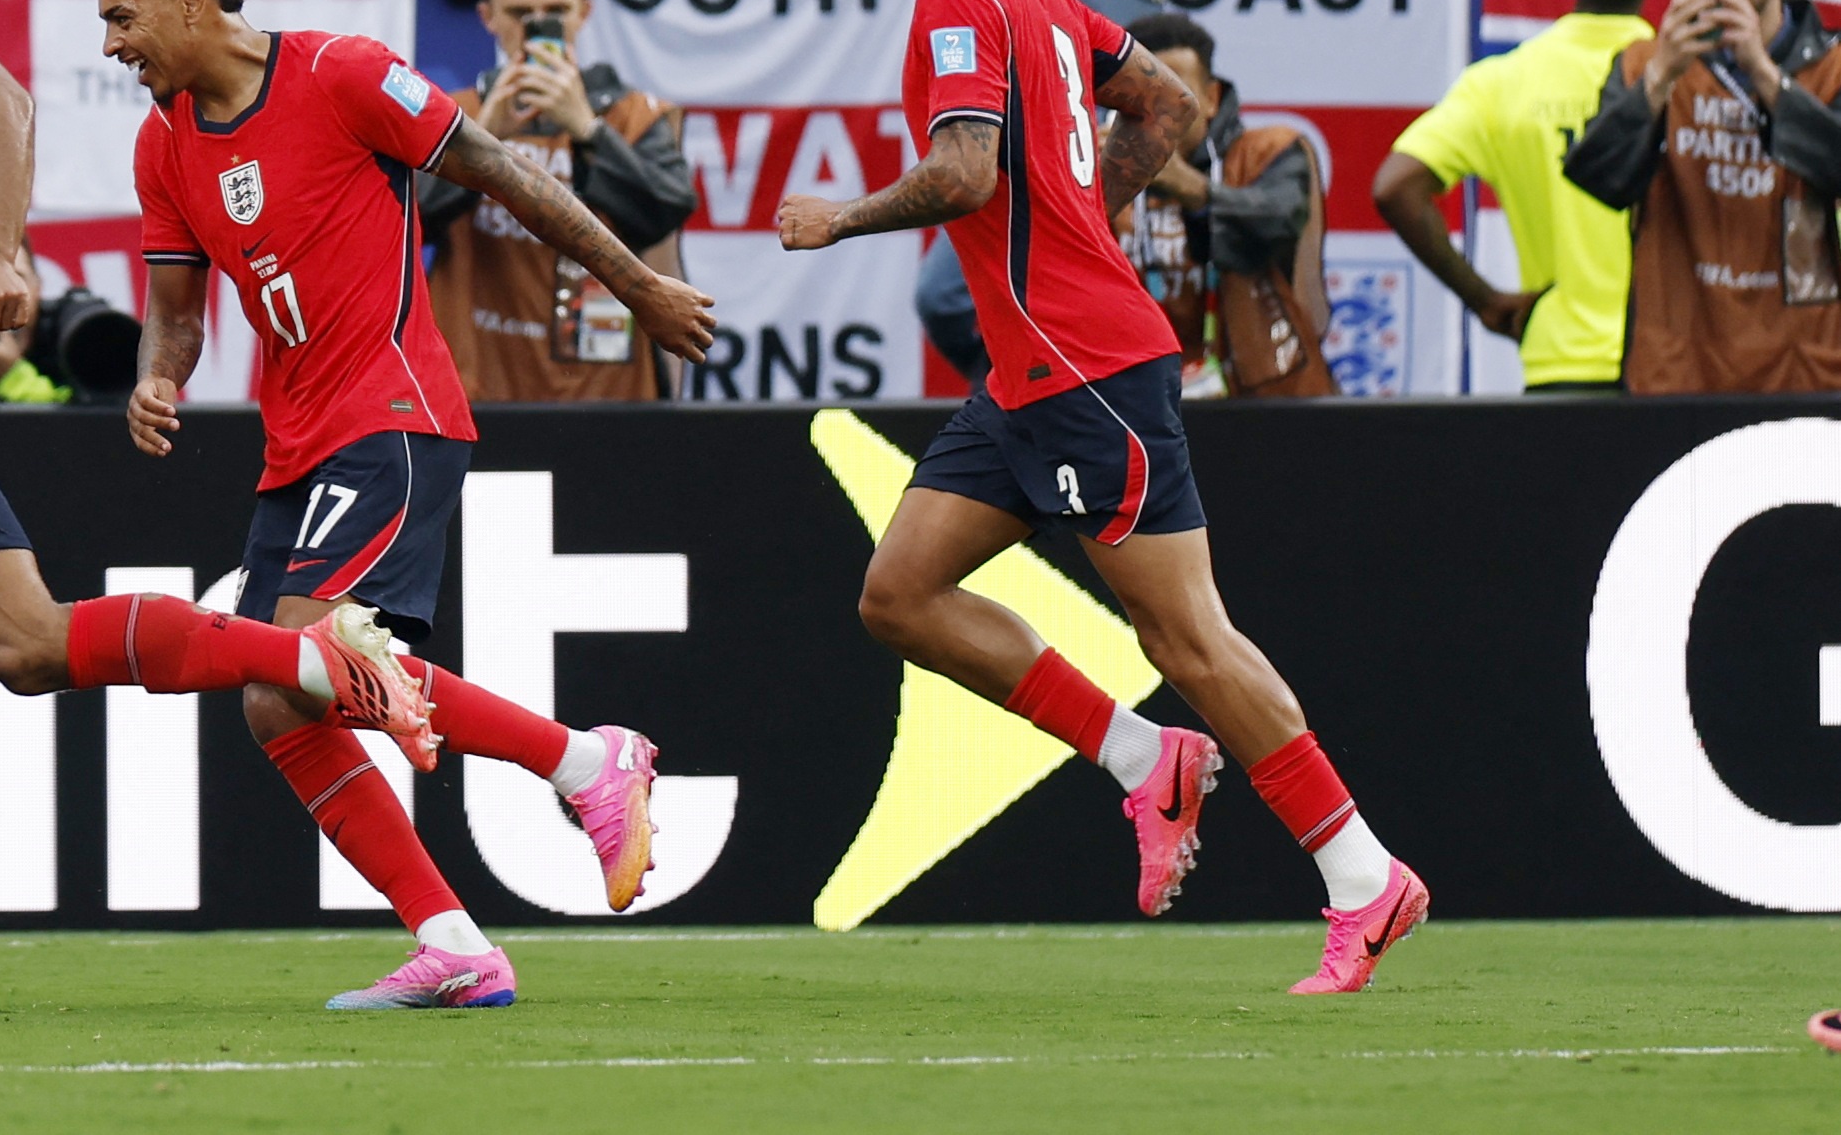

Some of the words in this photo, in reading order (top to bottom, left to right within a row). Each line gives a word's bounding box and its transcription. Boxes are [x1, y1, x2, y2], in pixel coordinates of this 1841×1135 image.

[1051, 22, 1095, 189] 3
[261, 272, 308, 348] 17
[692, 324, 883, 400] RNS
[295, 483, 358, 549] 17
[1056, 463, 1088, 515] 3
